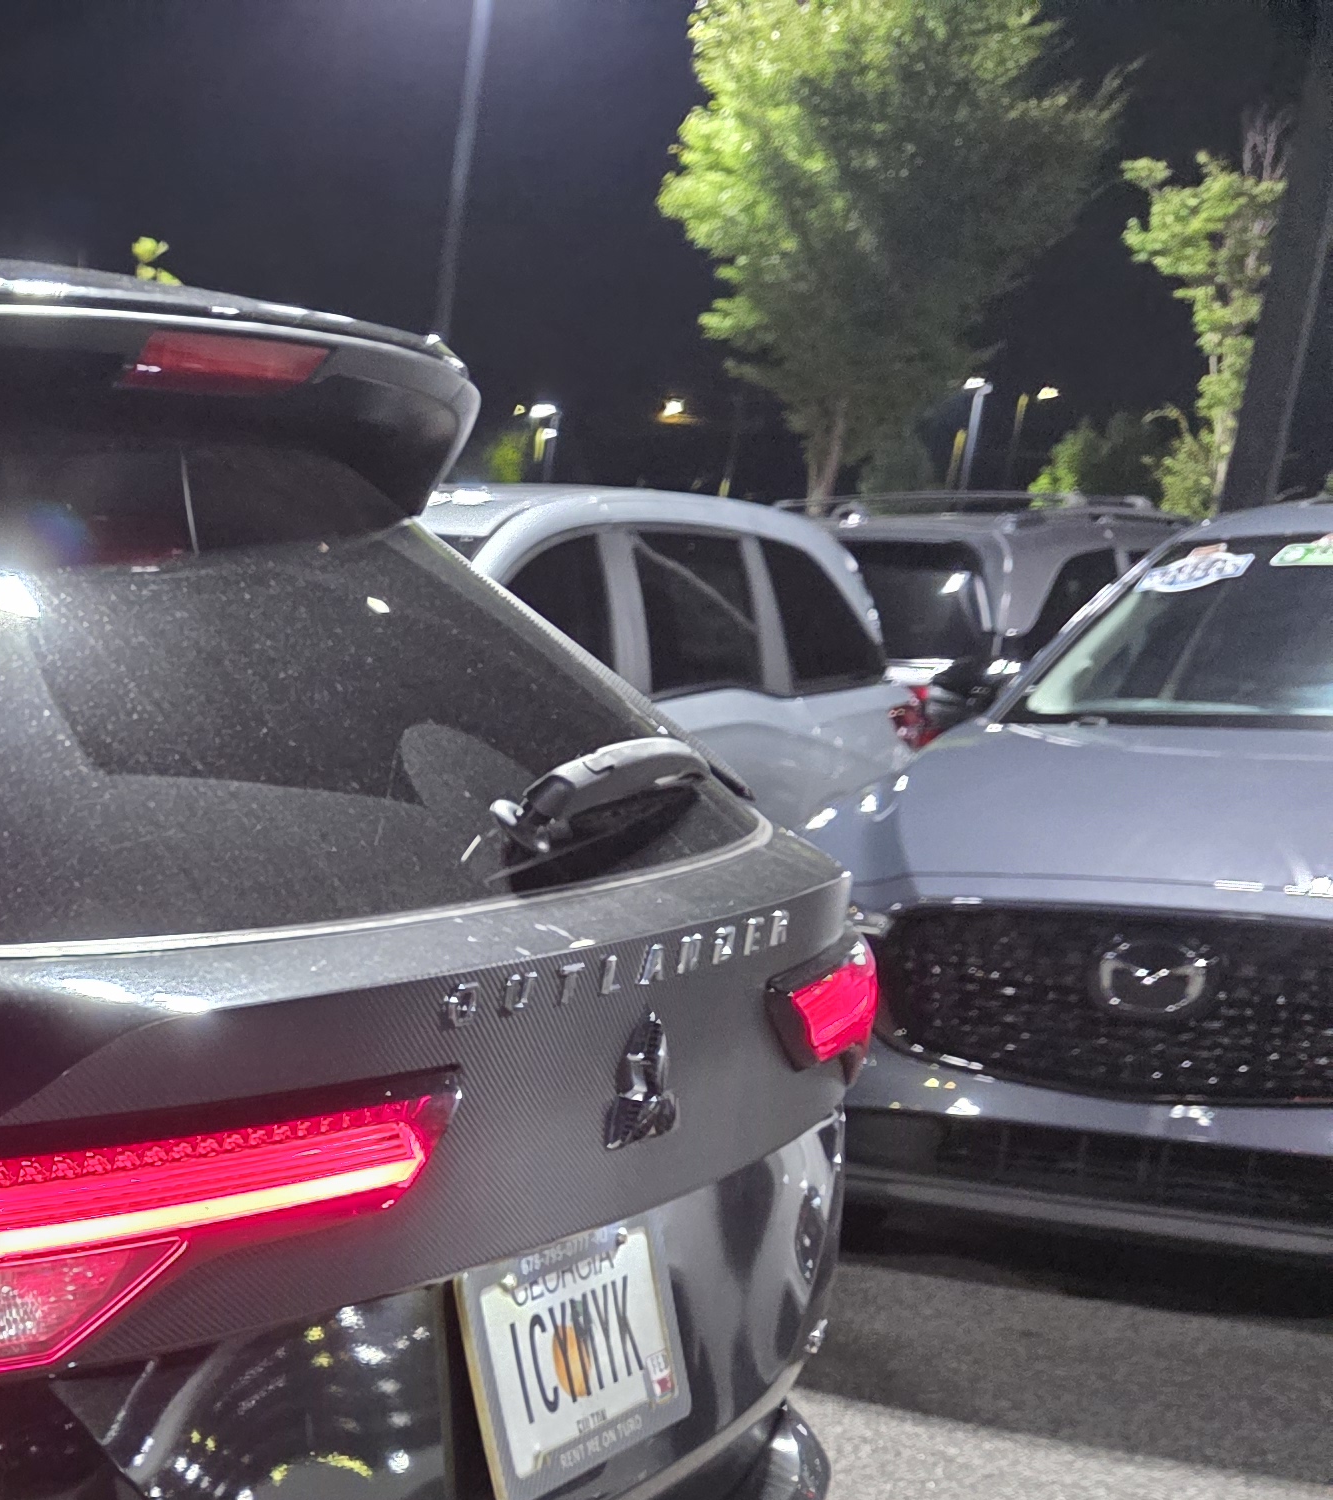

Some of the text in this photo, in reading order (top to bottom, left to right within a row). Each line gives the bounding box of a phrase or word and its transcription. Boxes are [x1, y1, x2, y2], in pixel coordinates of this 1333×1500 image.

[441, 910, 790, 1028] OUTLANDER
[512, 1250, 615, 1307] GEORGIA
[510, 1275, 645, 1424] ICYMYK
